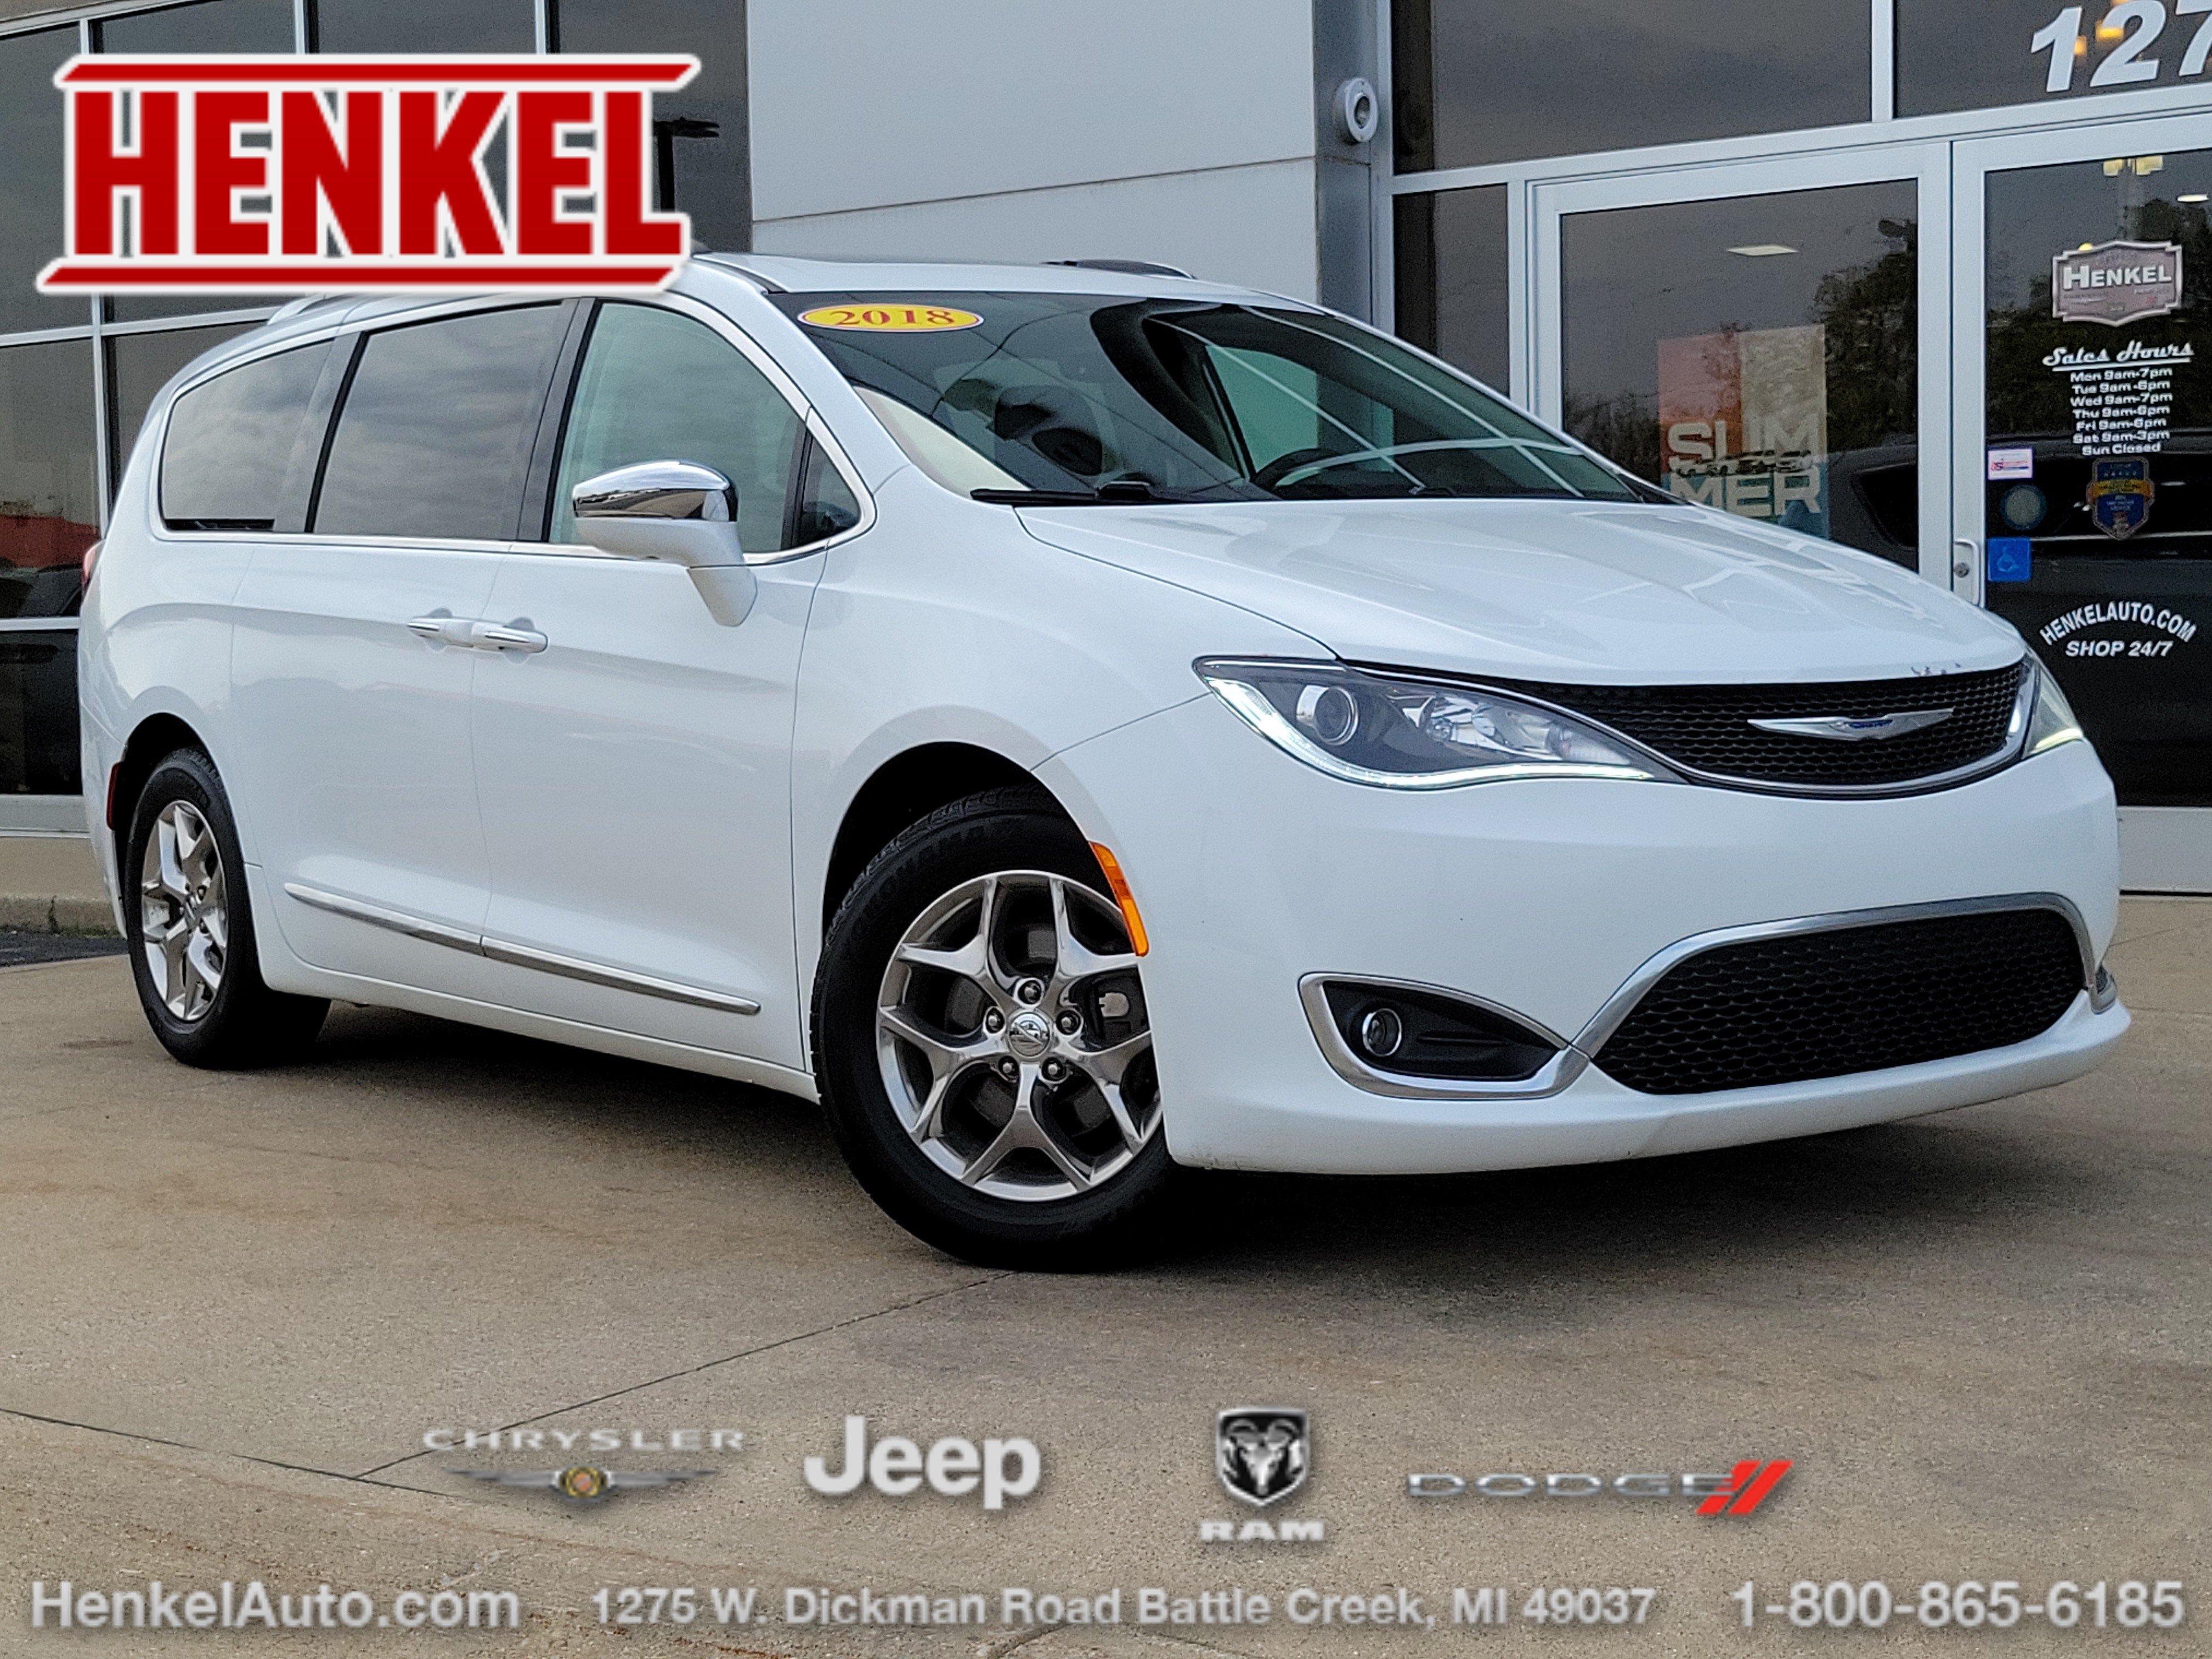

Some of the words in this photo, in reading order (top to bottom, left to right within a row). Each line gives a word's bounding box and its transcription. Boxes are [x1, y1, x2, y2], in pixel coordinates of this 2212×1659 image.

[2063, 265, 2172, 290] HENKEL
[830, 309, 955, 326] 2018
[2042, 347, 2110, 366] Sales
[2117, 340, 2194, 363] Hours
[2070, 372, 2102, 382] Mon
[2104, 368, 2172, 380] 9am-7pm
[2072, 384, 2097, 394] Tue
[2070, 395, 2102, 407] Wed
[2104, 392, 2173, 404] 9am-7pm
[2072, 408, 2100, 419] Thu
[2076, 420, 2096, 431] Fri
[2073, 432, 2100, 443] Sat
[2082, 444, 2111, 455] Sun
[2112, 442, 2162, 454] Closed
[2039, 601, 2197, 645] HENKELAUTO.COM
[2065, 641, 2125, 657] SHOP
[2128, 640, 2174, 657] 24/7
